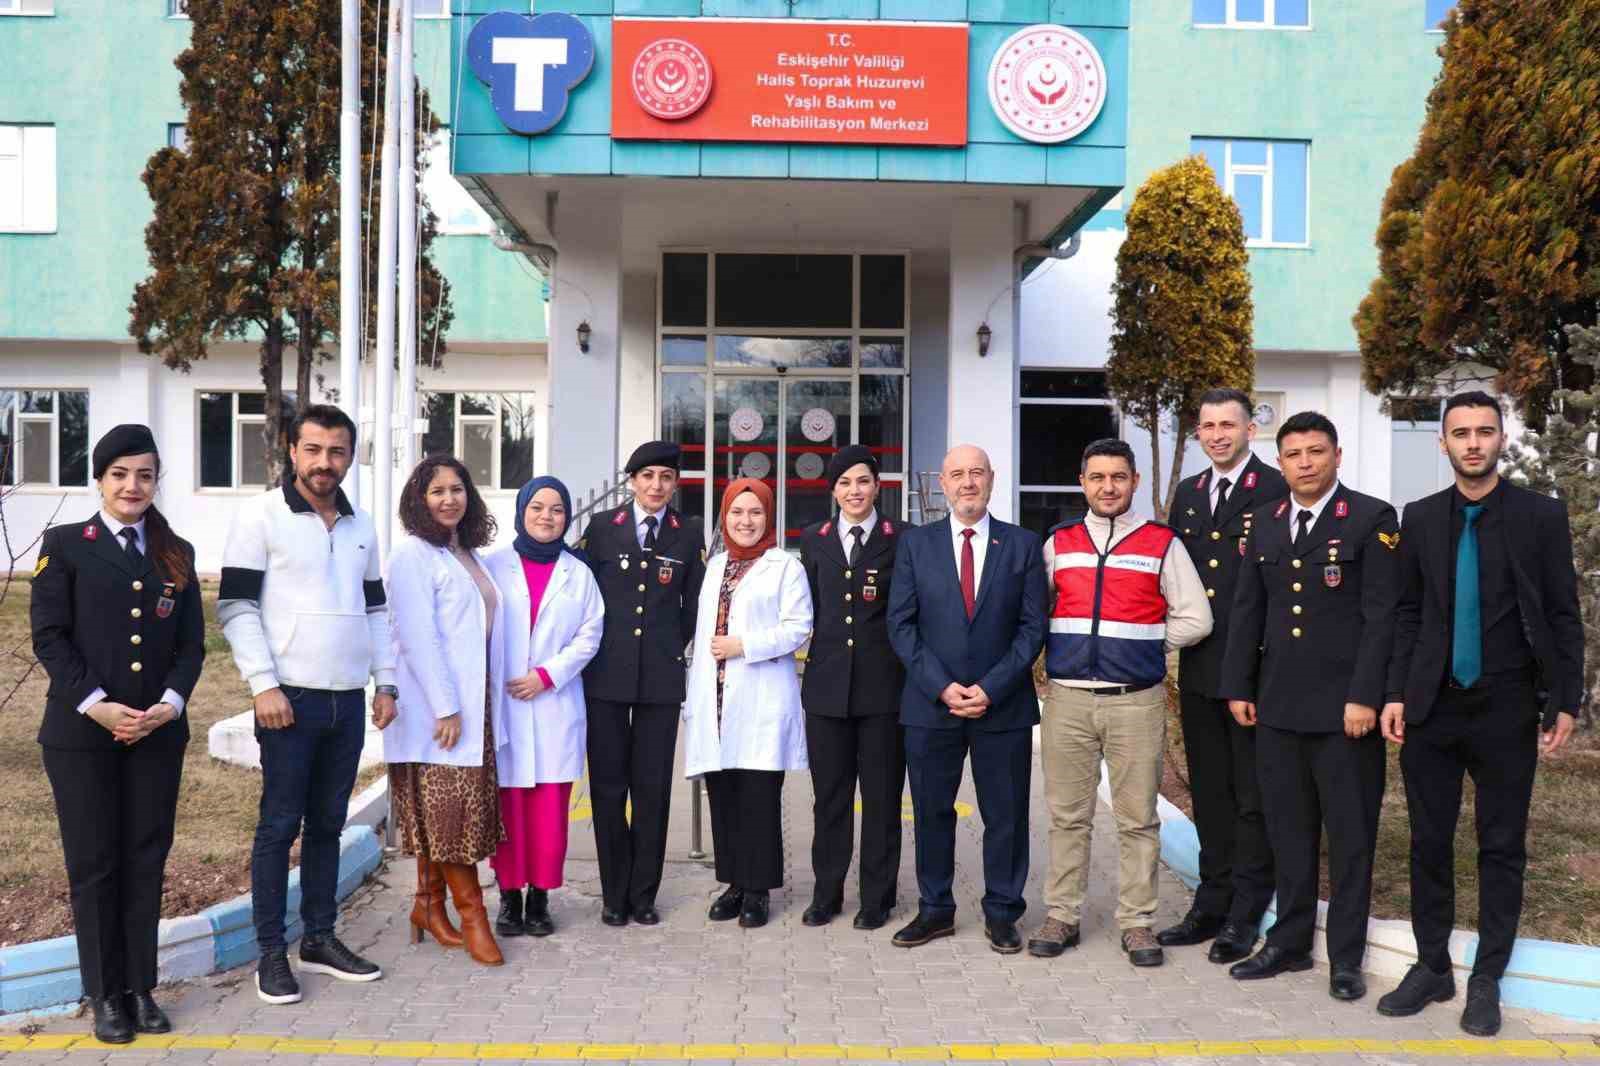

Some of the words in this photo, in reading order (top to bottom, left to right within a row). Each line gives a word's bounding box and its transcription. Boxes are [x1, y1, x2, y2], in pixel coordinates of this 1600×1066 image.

[827, 33, 855, 47] T.C.
[777, 53, 849, 69] Eskişehir
[853, 54, 904, 70] Valiliği
[492, 37, 567, 111] T
[757, 74, 795, 87] Halis
[800, 74, 851, 90] Toprak
[857, 75, 925, 89] Huzurevi
[784, 94, 821, 110] Yaşlı
[826, 95, 874, 109] Bakım
[879, 99, 896, 109] ve
[751, 114, 865, 132] Rehabilitasyon
[870, 116, 929, 131] Merkezi
